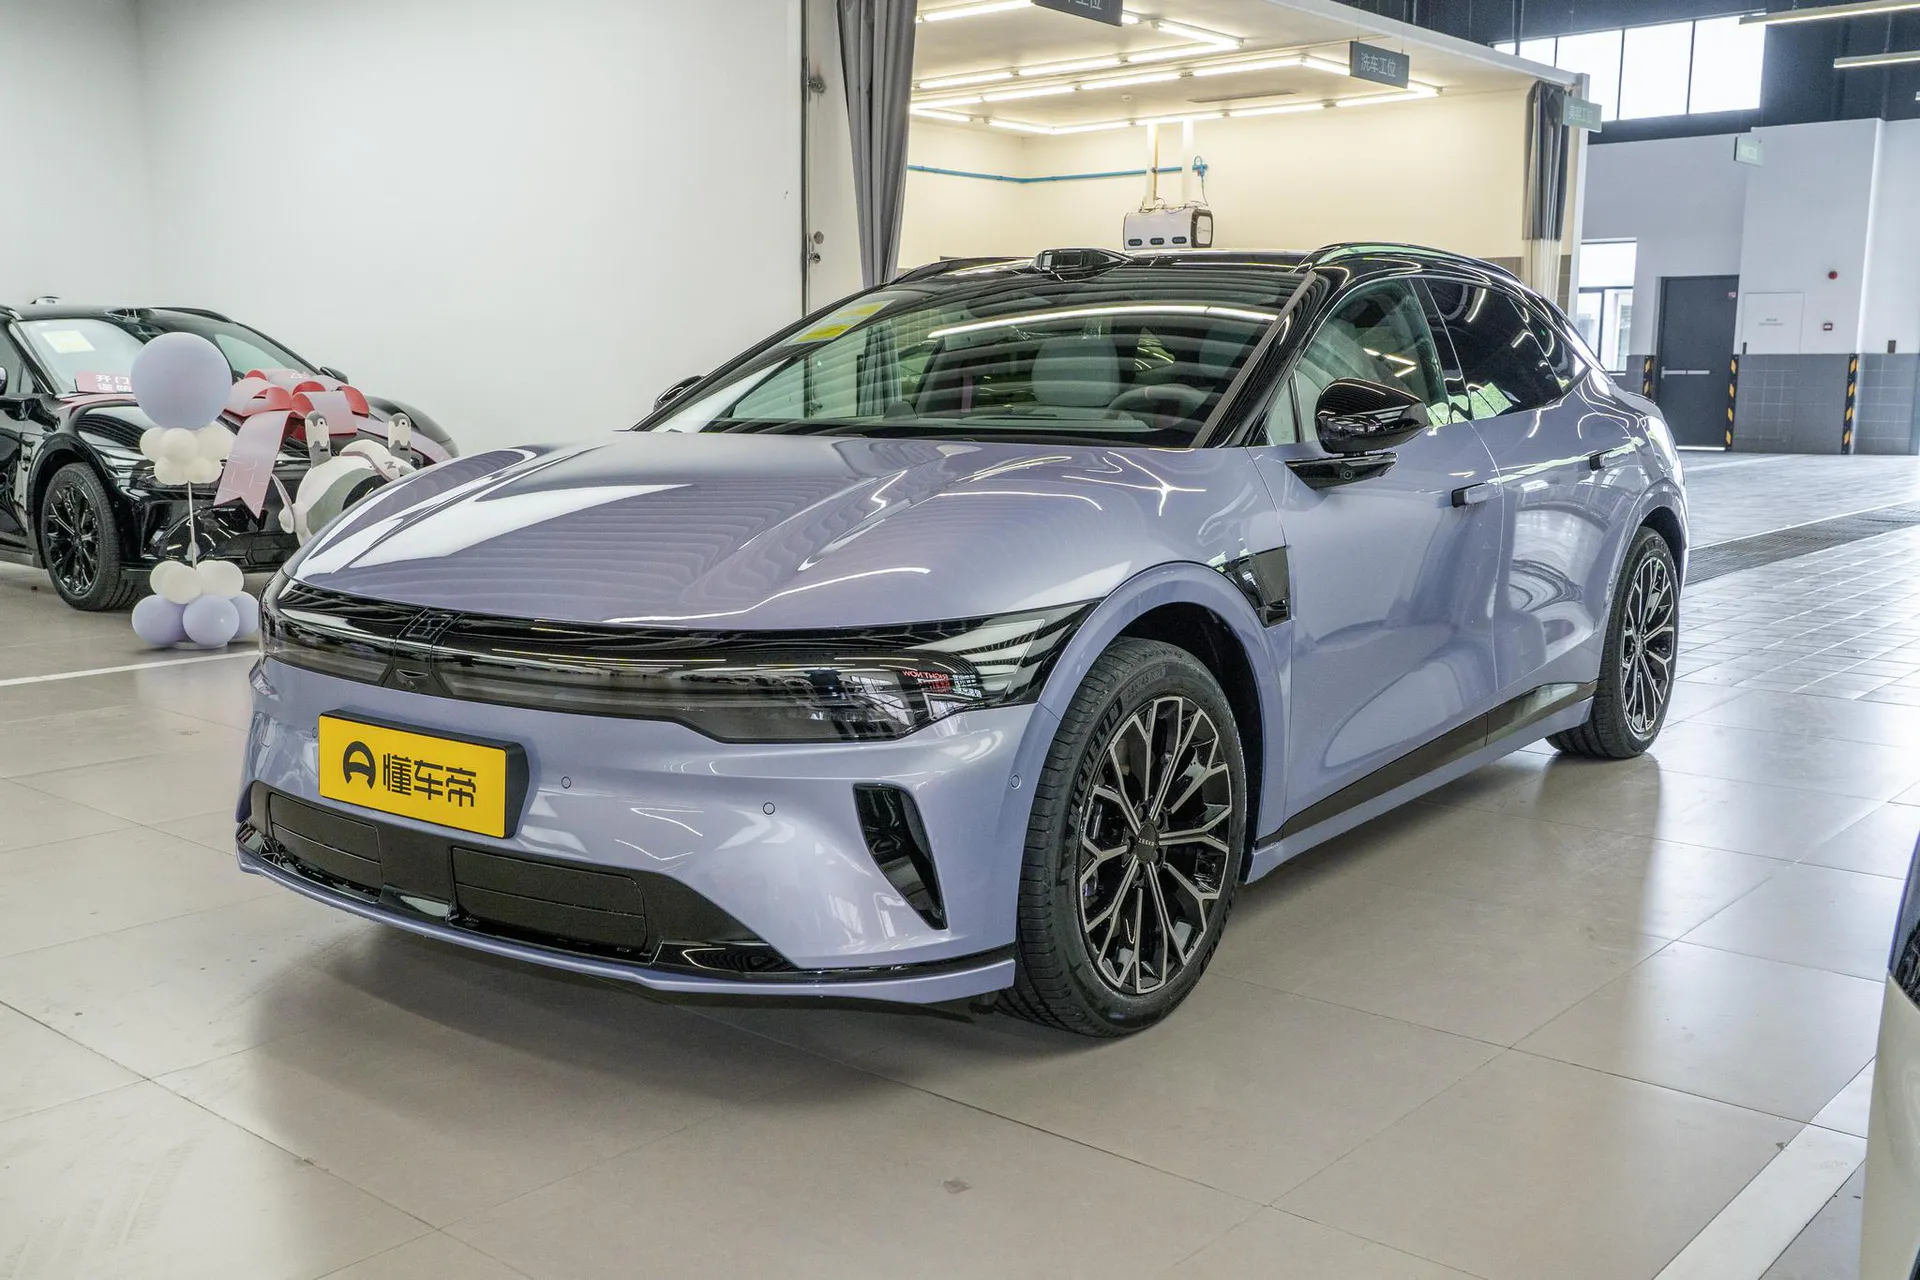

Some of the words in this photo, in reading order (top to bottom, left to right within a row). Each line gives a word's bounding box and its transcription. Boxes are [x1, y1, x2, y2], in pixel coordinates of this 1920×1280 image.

[1360, 52, 1396, 77] 洗车工位
[383, 752, 477, 807] 懂车帝
[1067, 701, 1121, 830] MICHELIN
